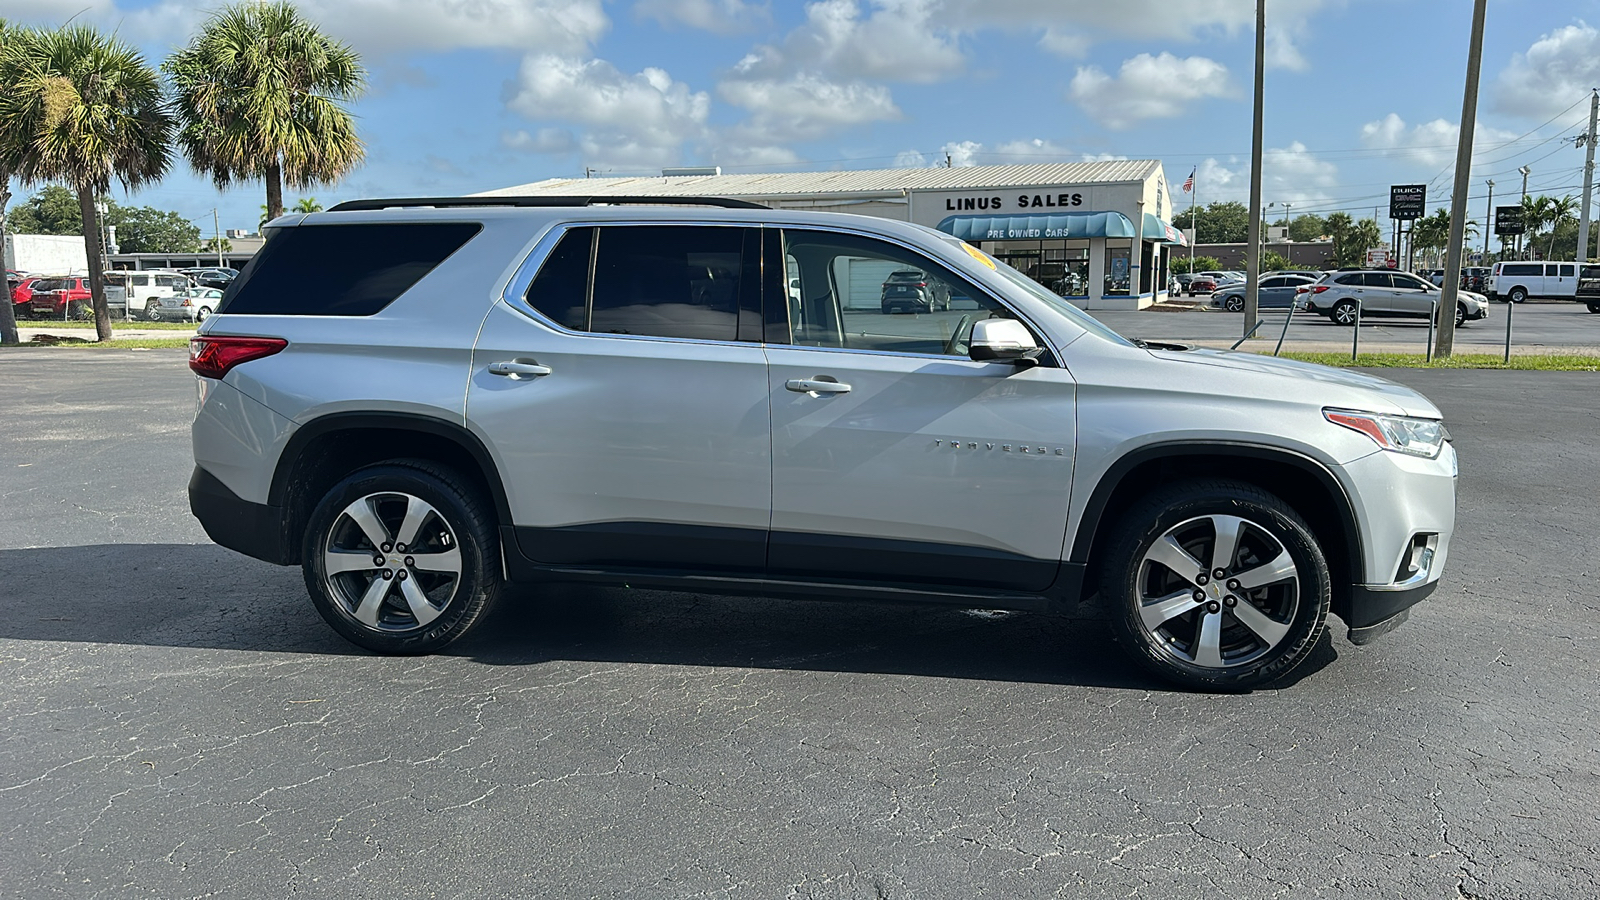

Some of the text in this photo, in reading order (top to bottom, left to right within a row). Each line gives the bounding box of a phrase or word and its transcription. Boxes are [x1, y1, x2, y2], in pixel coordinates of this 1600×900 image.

[946, 193, 1083, 211] LINUS SALES
[987, 228, 1069, 239] PRE OWNED CARS
[935, 438, 1064, 455] TRAVERSE
